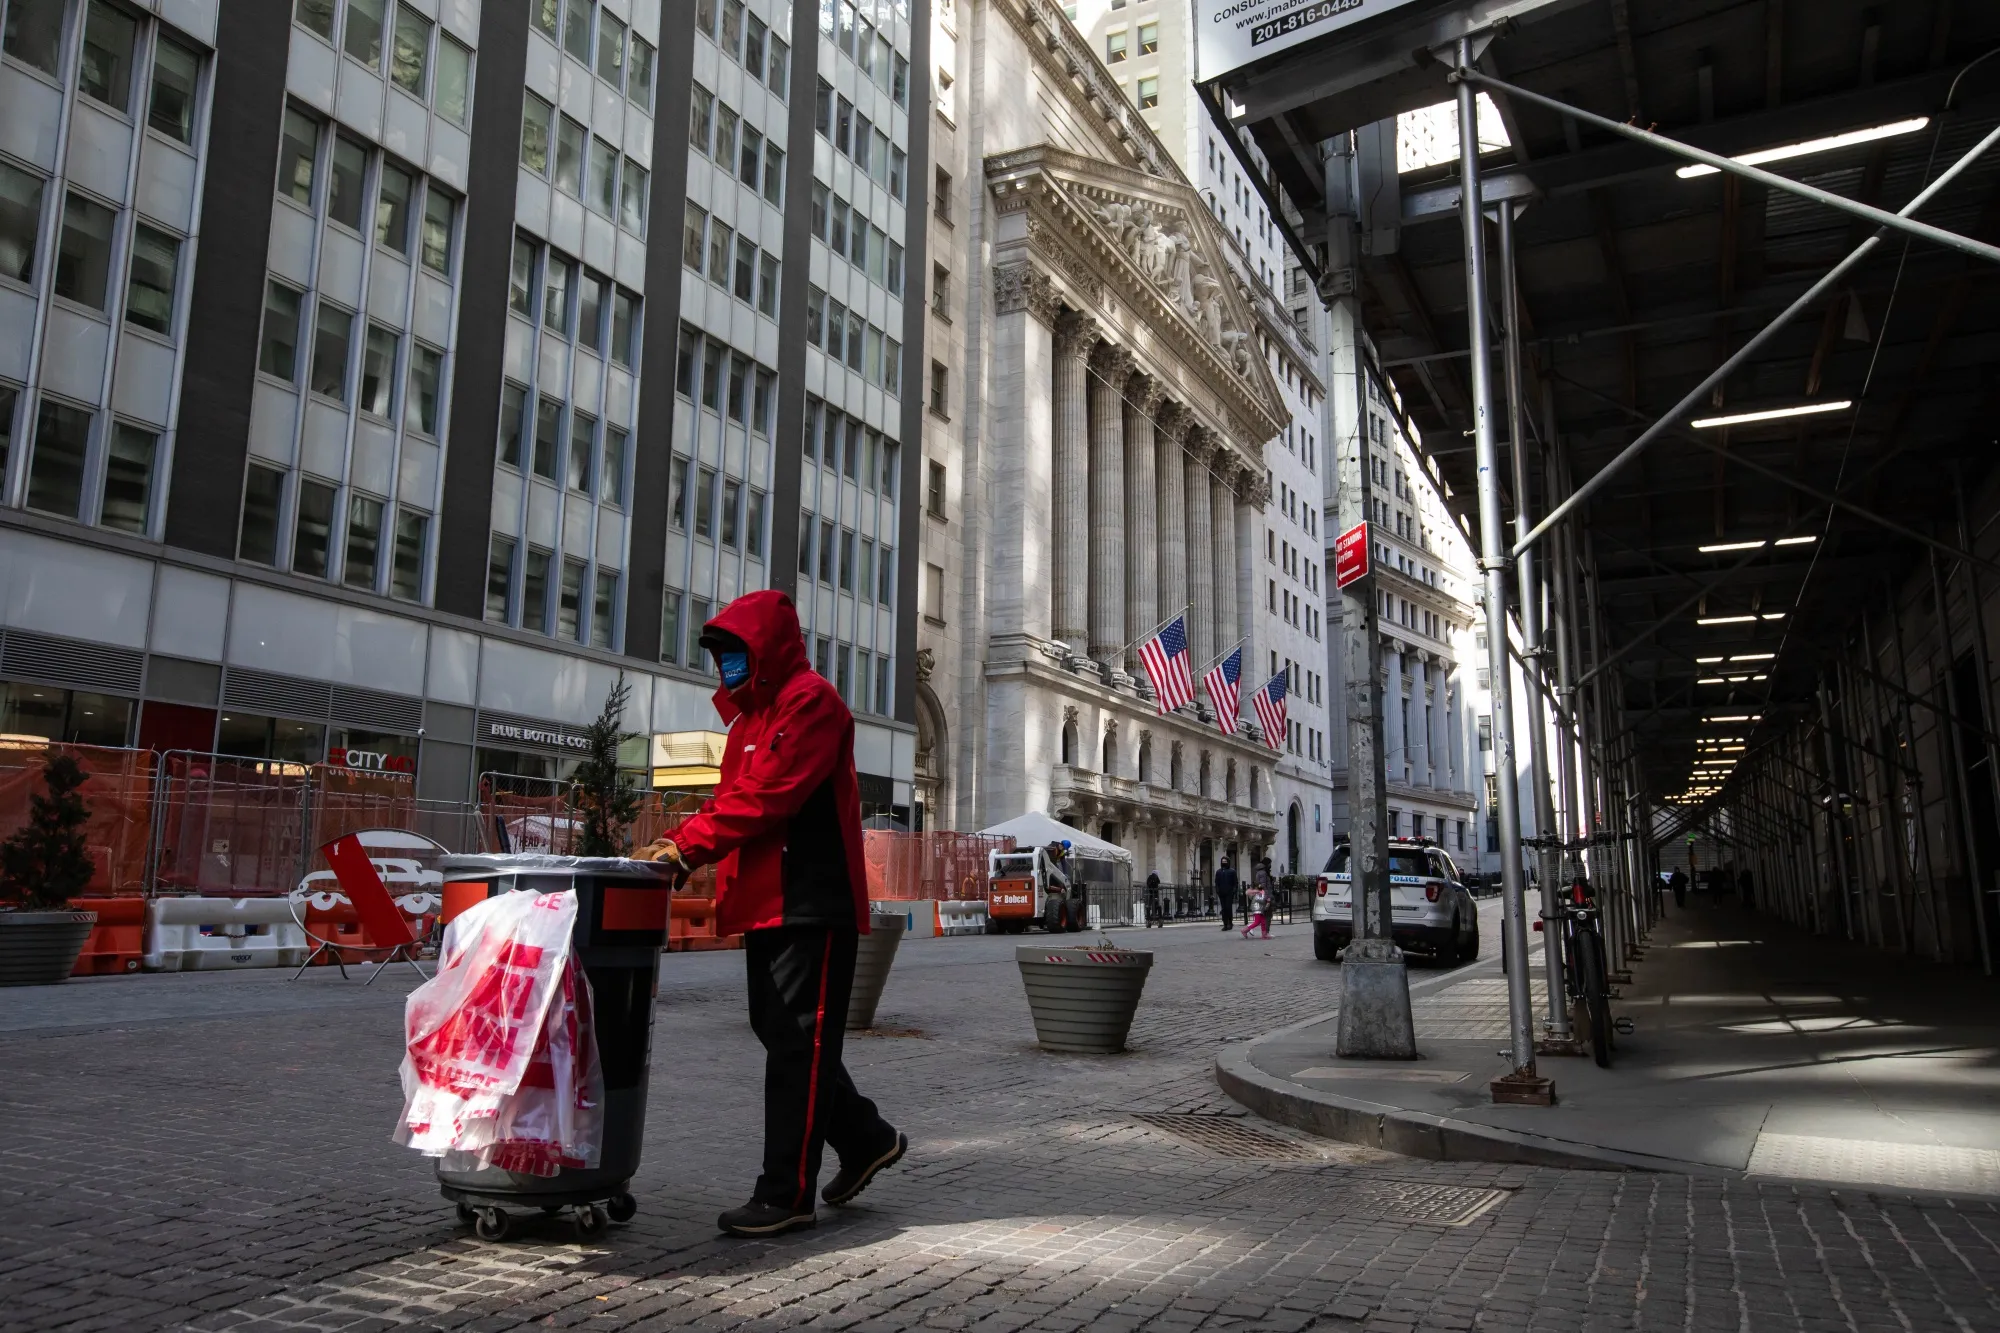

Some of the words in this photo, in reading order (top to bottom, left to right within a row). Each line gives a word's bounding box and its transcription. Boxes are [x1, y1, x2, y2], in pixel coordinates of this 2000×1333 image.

[1213, 0, 1270, 23] CONSU
[1235, 0, 1308, 29] www.jmabu
[1343, 530, 1363, 548] STANDING
[1337, 549, 1354, 564] Anytime
[491, 724, 521, 739] BLUE
[523, 728, 565, 746] BOTTLE
[1004, 894, 1029, 904] Bobcat
